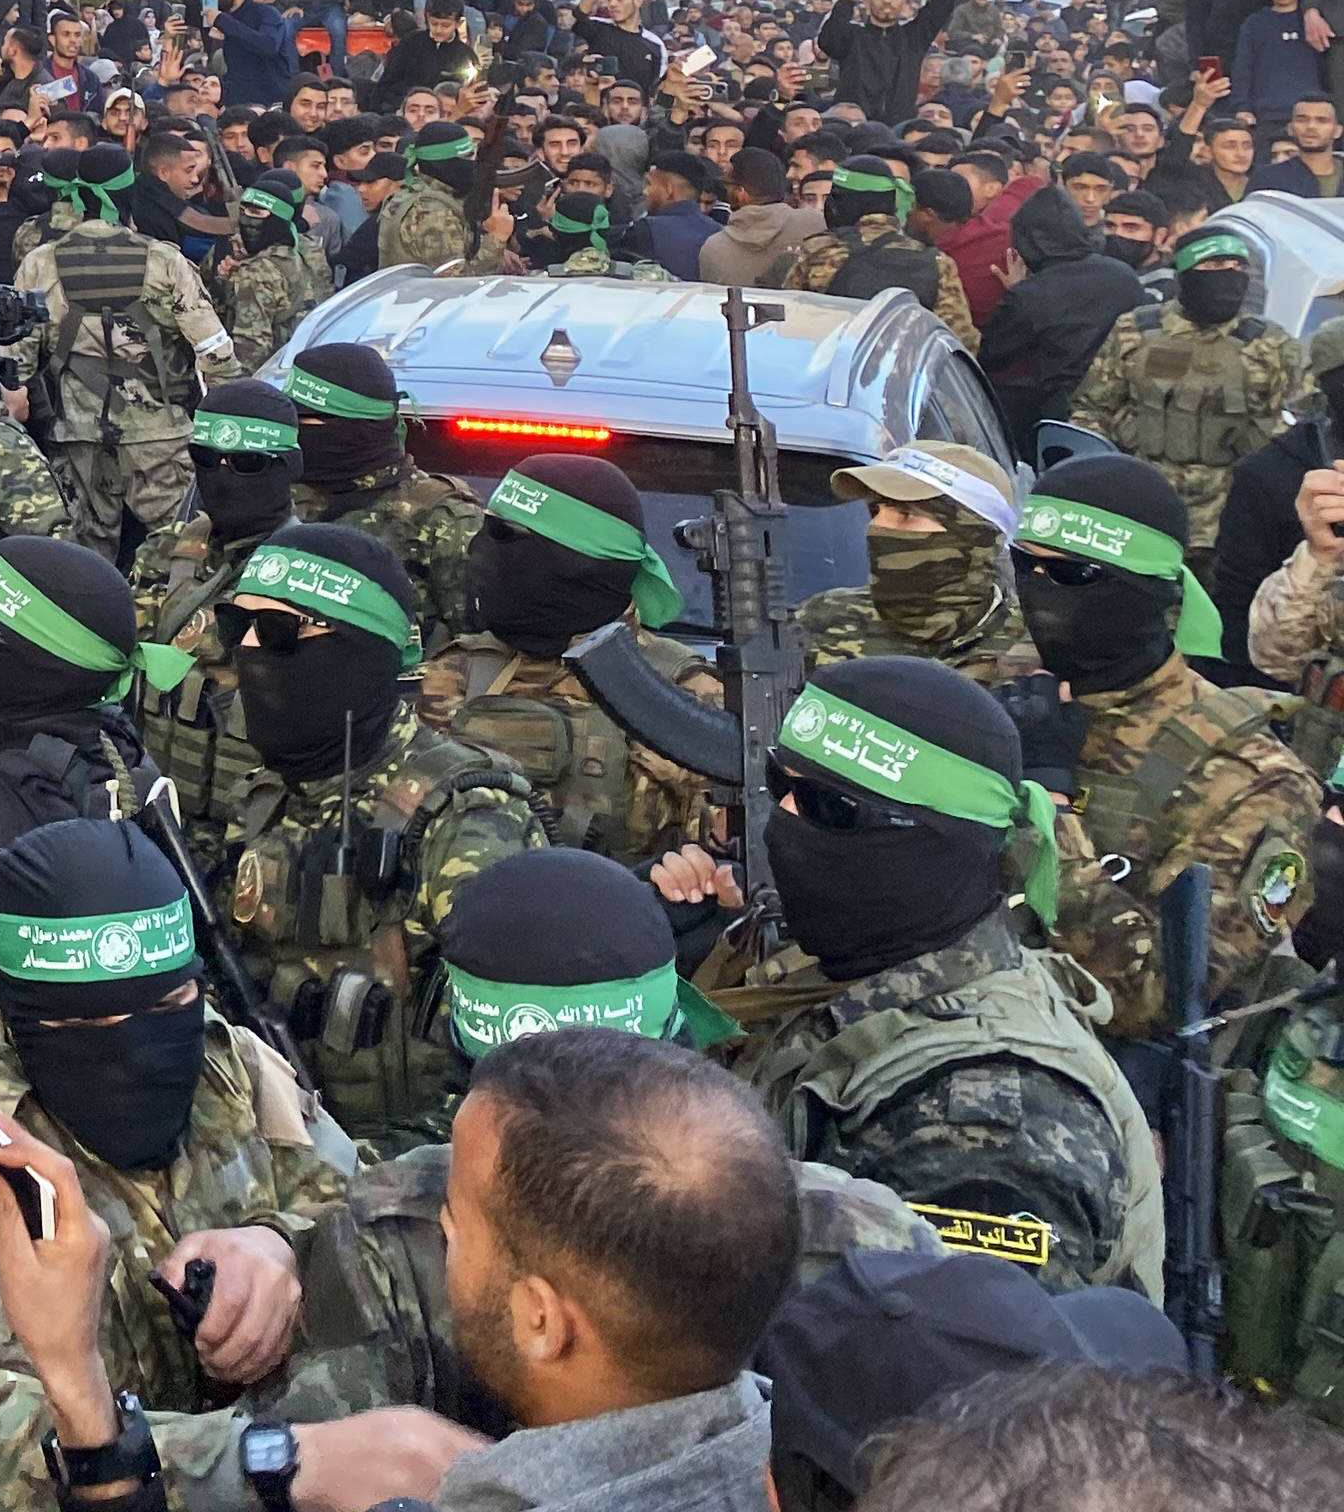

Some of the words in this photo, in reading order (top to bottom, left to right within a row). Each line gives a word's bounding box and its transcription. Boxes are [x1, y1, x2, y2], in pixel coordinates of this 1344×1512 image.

[1060, 526, 1127, 557] كتائب
[286, 573, 354, 606] كتائب
[826, 709, 849, 729] الله
[848, 715, 866, 740] إلا
[864, 727, 906, 759] إله
[906, 744, 920, 762] لا
[820, 731, 909, 784] كتائب
[132, 914, 152, 932] الله
[31, 925, 58, 945] رسول
[61, 928, 93, 943] محمد
[21, 948, 92, 970] القسام
[472, 998, 501, 1017] محمد
[602, 997, 636, 1018] إله
[634, 992, 644, 1012] لا
[555, 1004, 581, 1023] الله
[582, 1004, 603, 1027] إلا
[936, 1218, 973, 1242] القس
[976, 1226, 1041, 1252] كتائب
